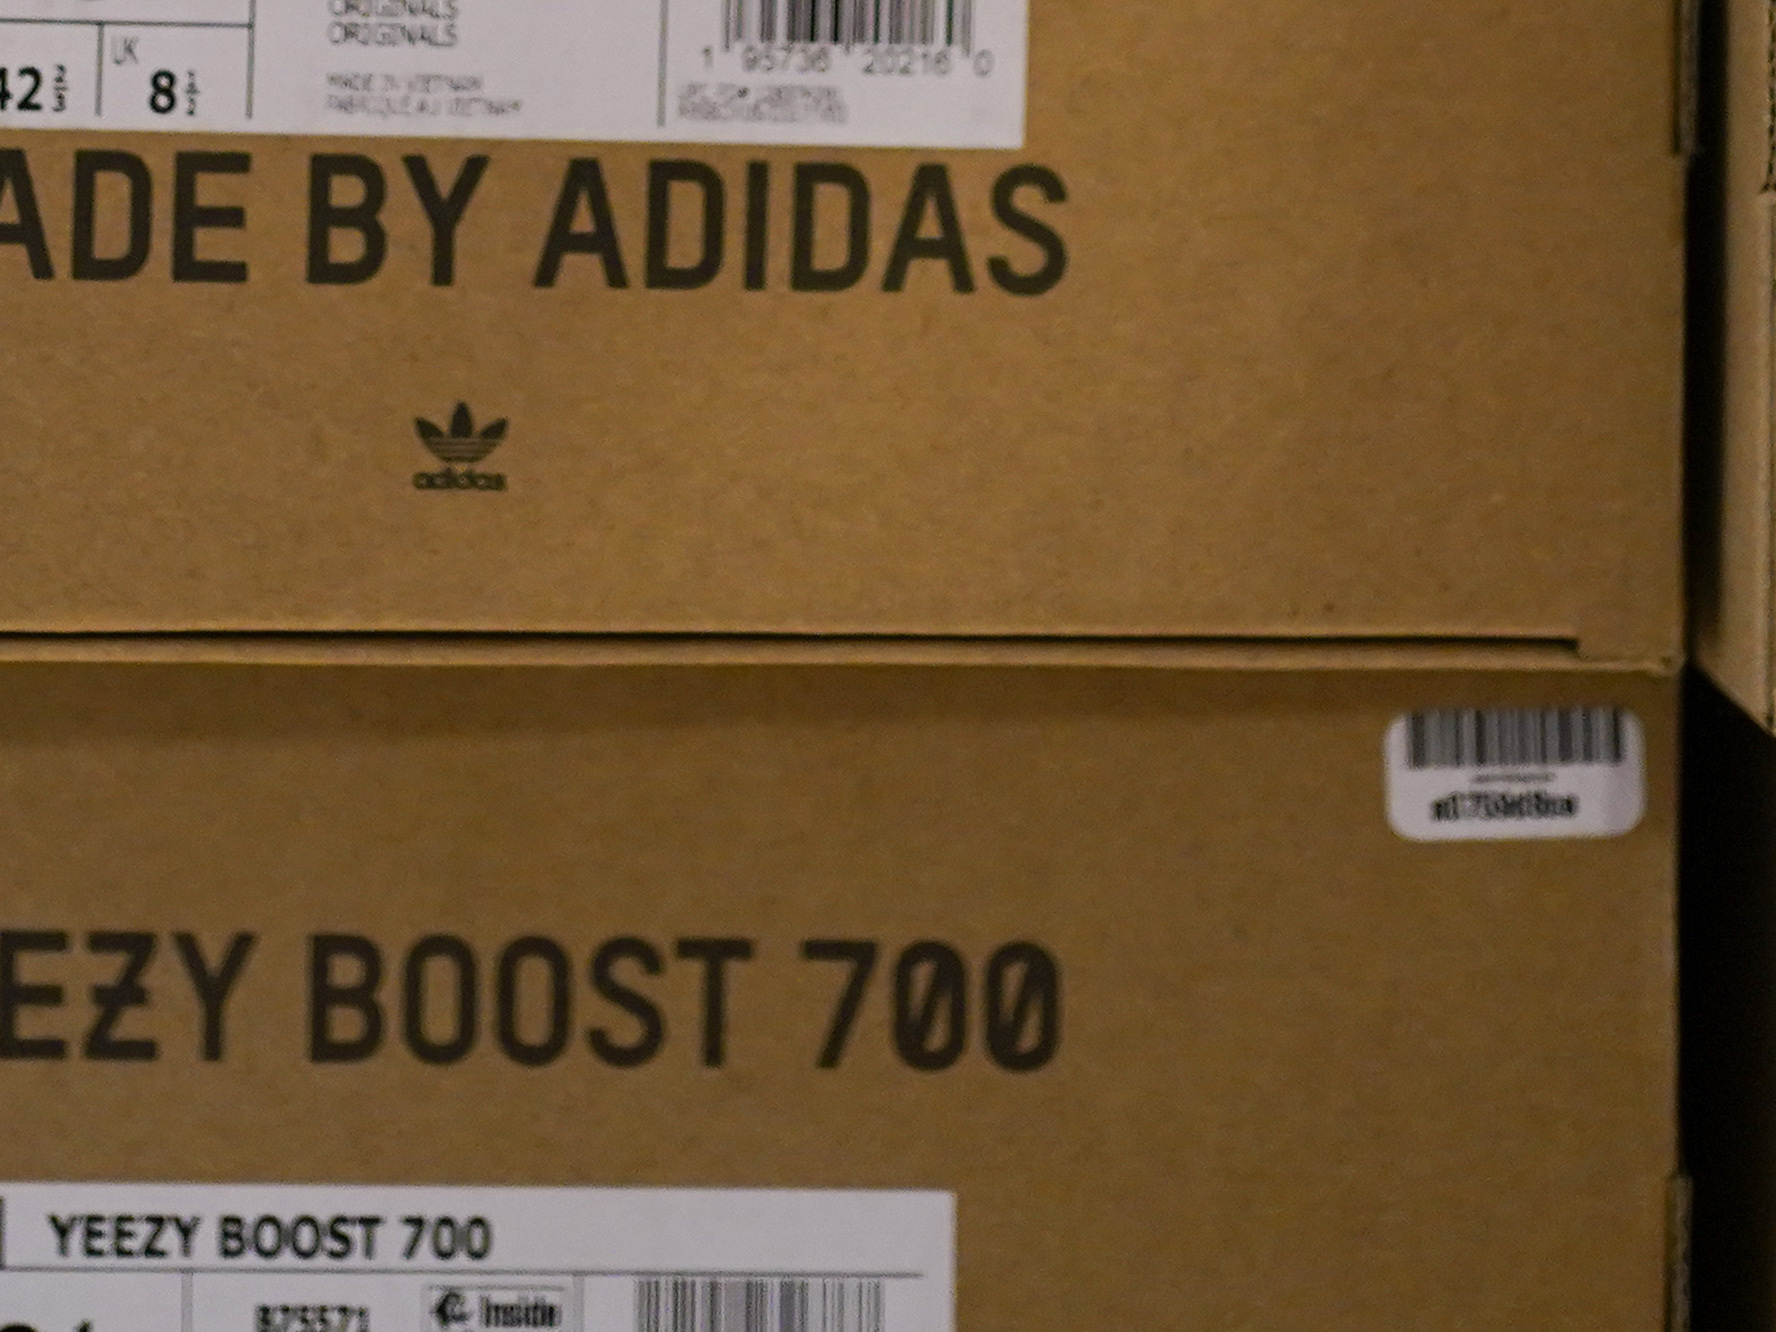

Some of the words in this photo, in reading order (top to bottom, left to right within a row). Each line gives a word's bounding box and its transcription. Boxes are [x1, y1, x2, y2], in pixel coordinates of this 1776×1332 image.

[307, 153, 489, 286] BY
[532, 157, 1067, 296] ADIDAS
[413, 467, 505, 491] adidas
[309, 933, 755, 1068] BOOST
[801, 939, 1060, 1073] 700
[50, 1215, 199, 1258] YEEZY
[220, 1215, 382, 1259] BOOST
[403, 1216, 490, 1260] 700
